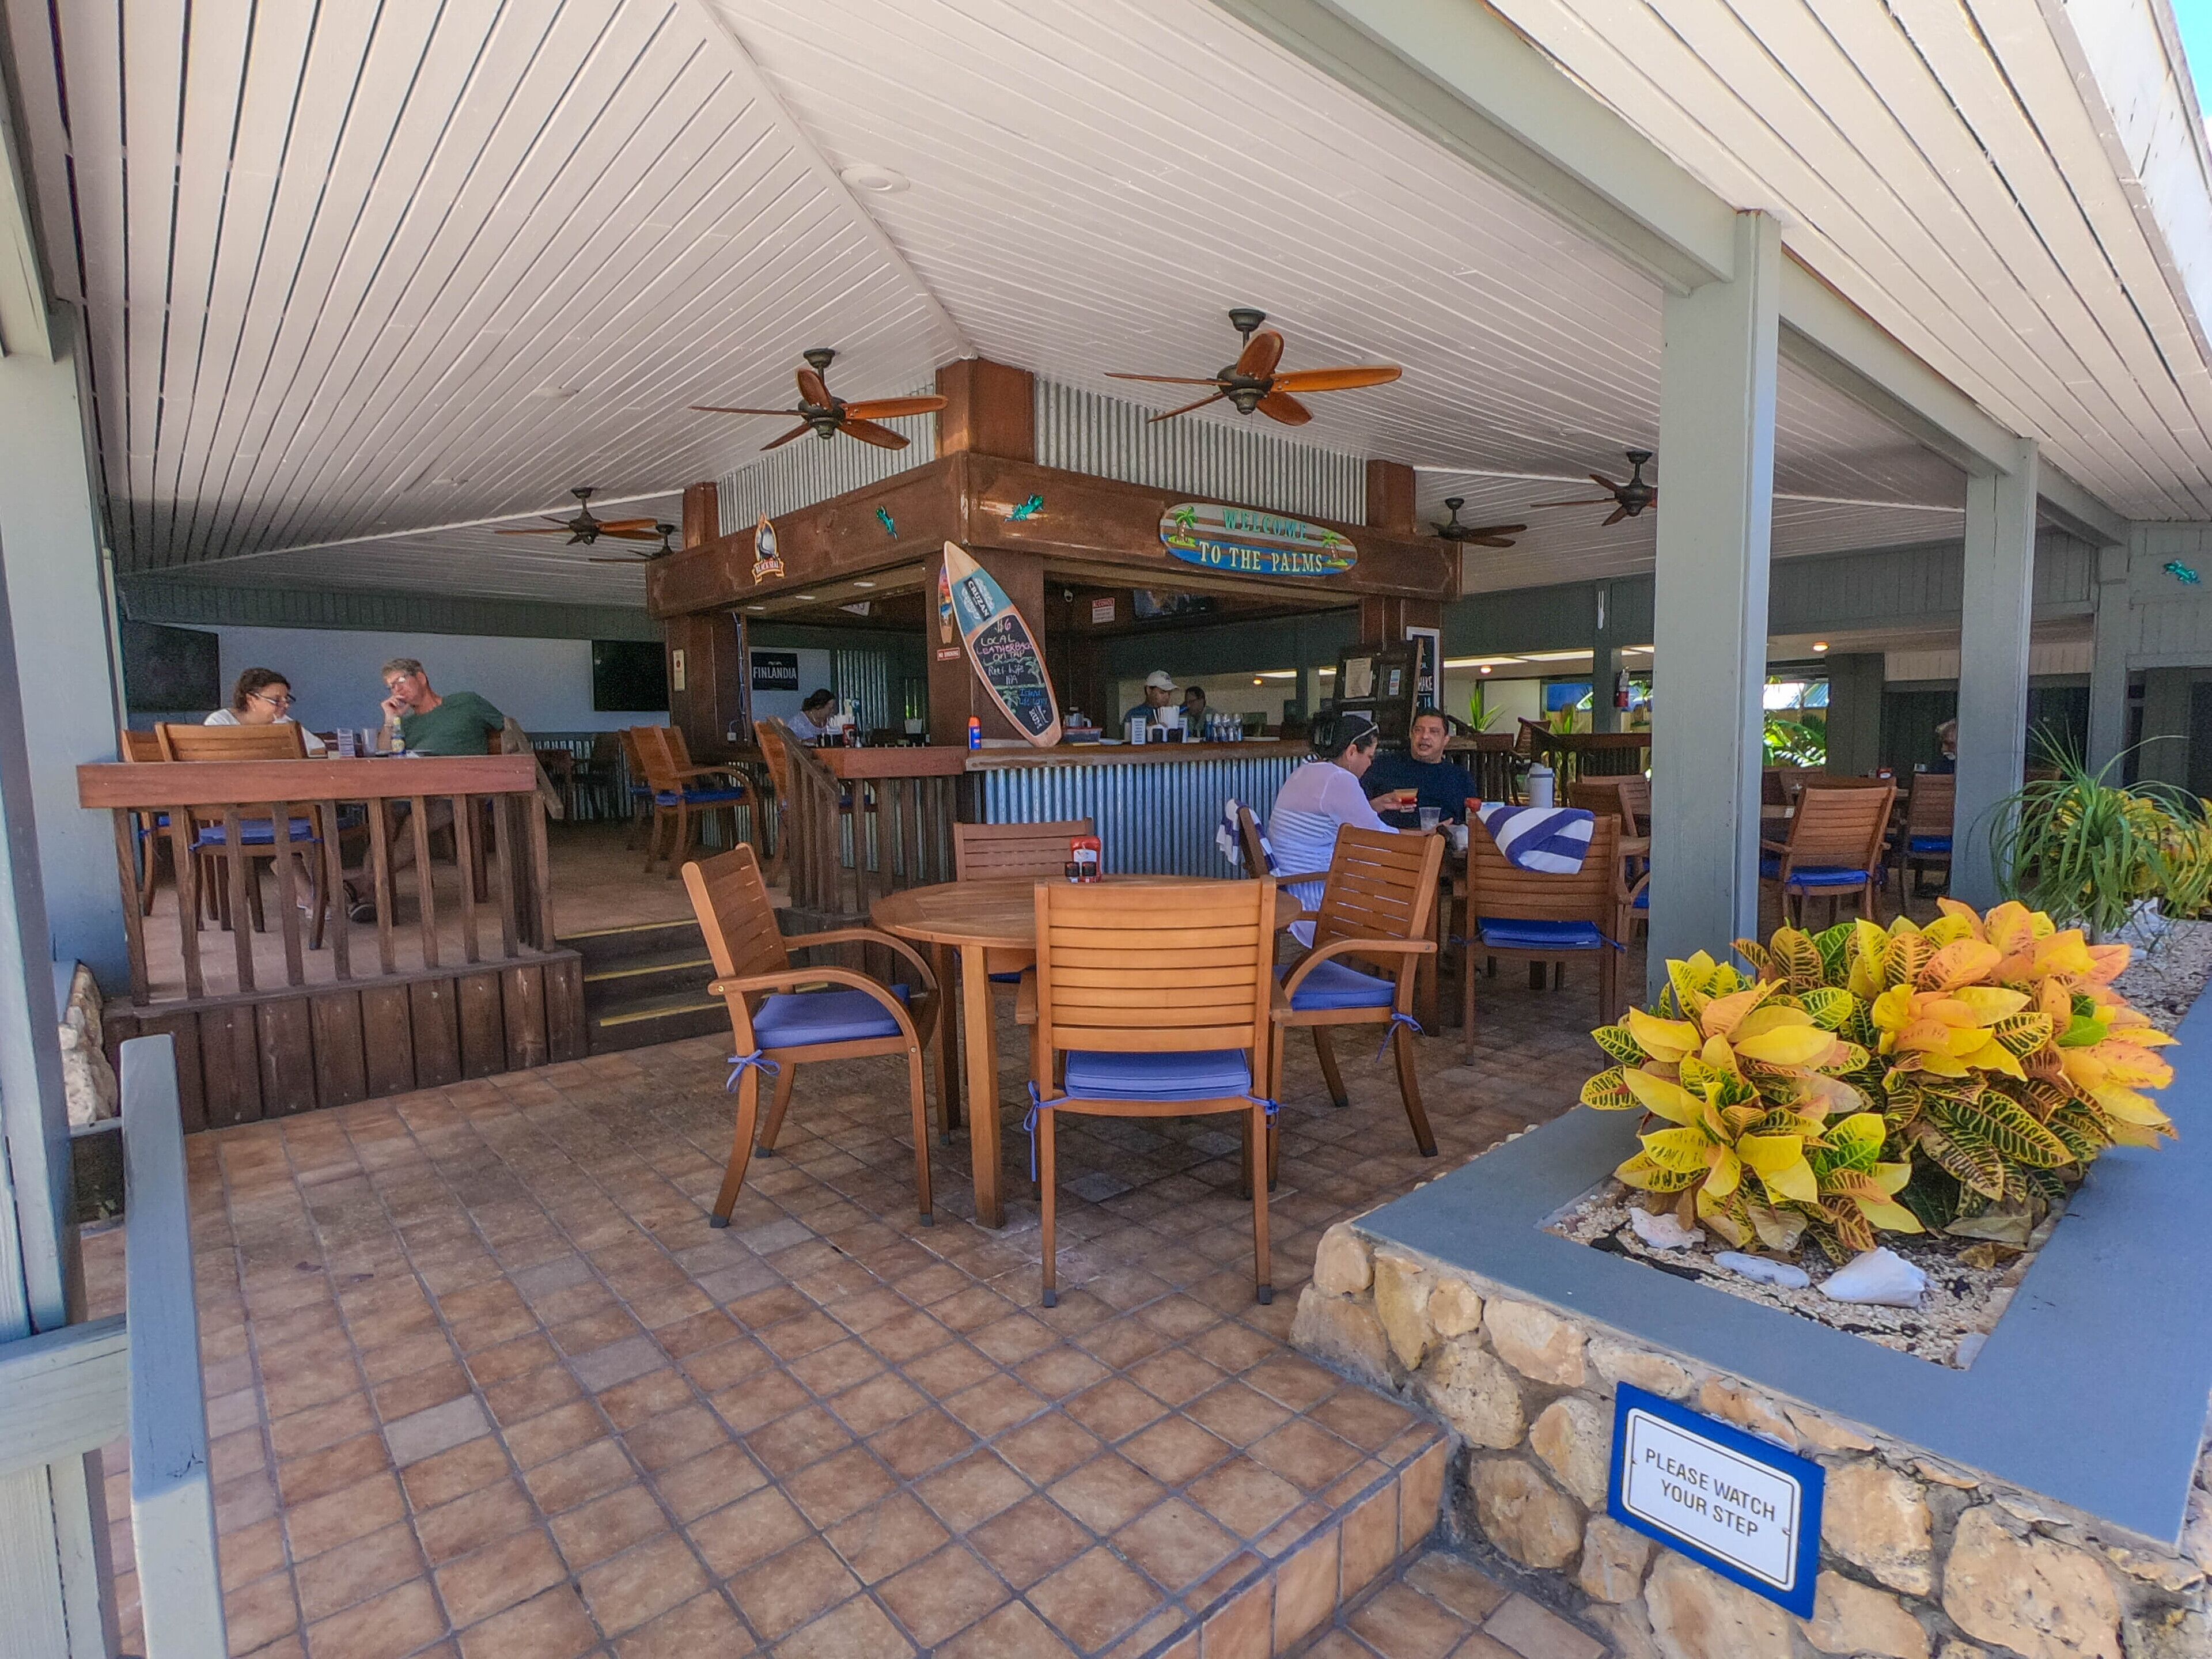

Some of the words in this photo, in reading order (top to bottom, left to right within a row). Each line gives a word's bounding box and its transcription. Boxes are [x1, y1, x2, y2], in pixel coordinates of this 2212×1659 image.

[1222, 508, 1308, 541] WELCOME
[1199, 541, 1221, 565] TO
[1229, 547, 1261, 571] THE
[1271, 552, 1323, 573] PALMS
[968, 581, 989, 617] CRUZAN
[995, 618, 1012, 633] $6
[980, 634, 1016, 646] LOCAL
[993, 653, 1006, 661] ON
[1010, 649, 1025, 658] TAP
[753, 666, 797, 679] FINLANDIA
[1005, 675, 1018, 685] IPA
[1029, 708, 1043, 729] RUM
[1645, 1448, 1709, 1492] PLEASE
[1714, 1478, 1776, 1522] WATCH
[1661, 1479, 1707, 1516] YOUR
[1713, 1505, 1759, 1537] STEP
